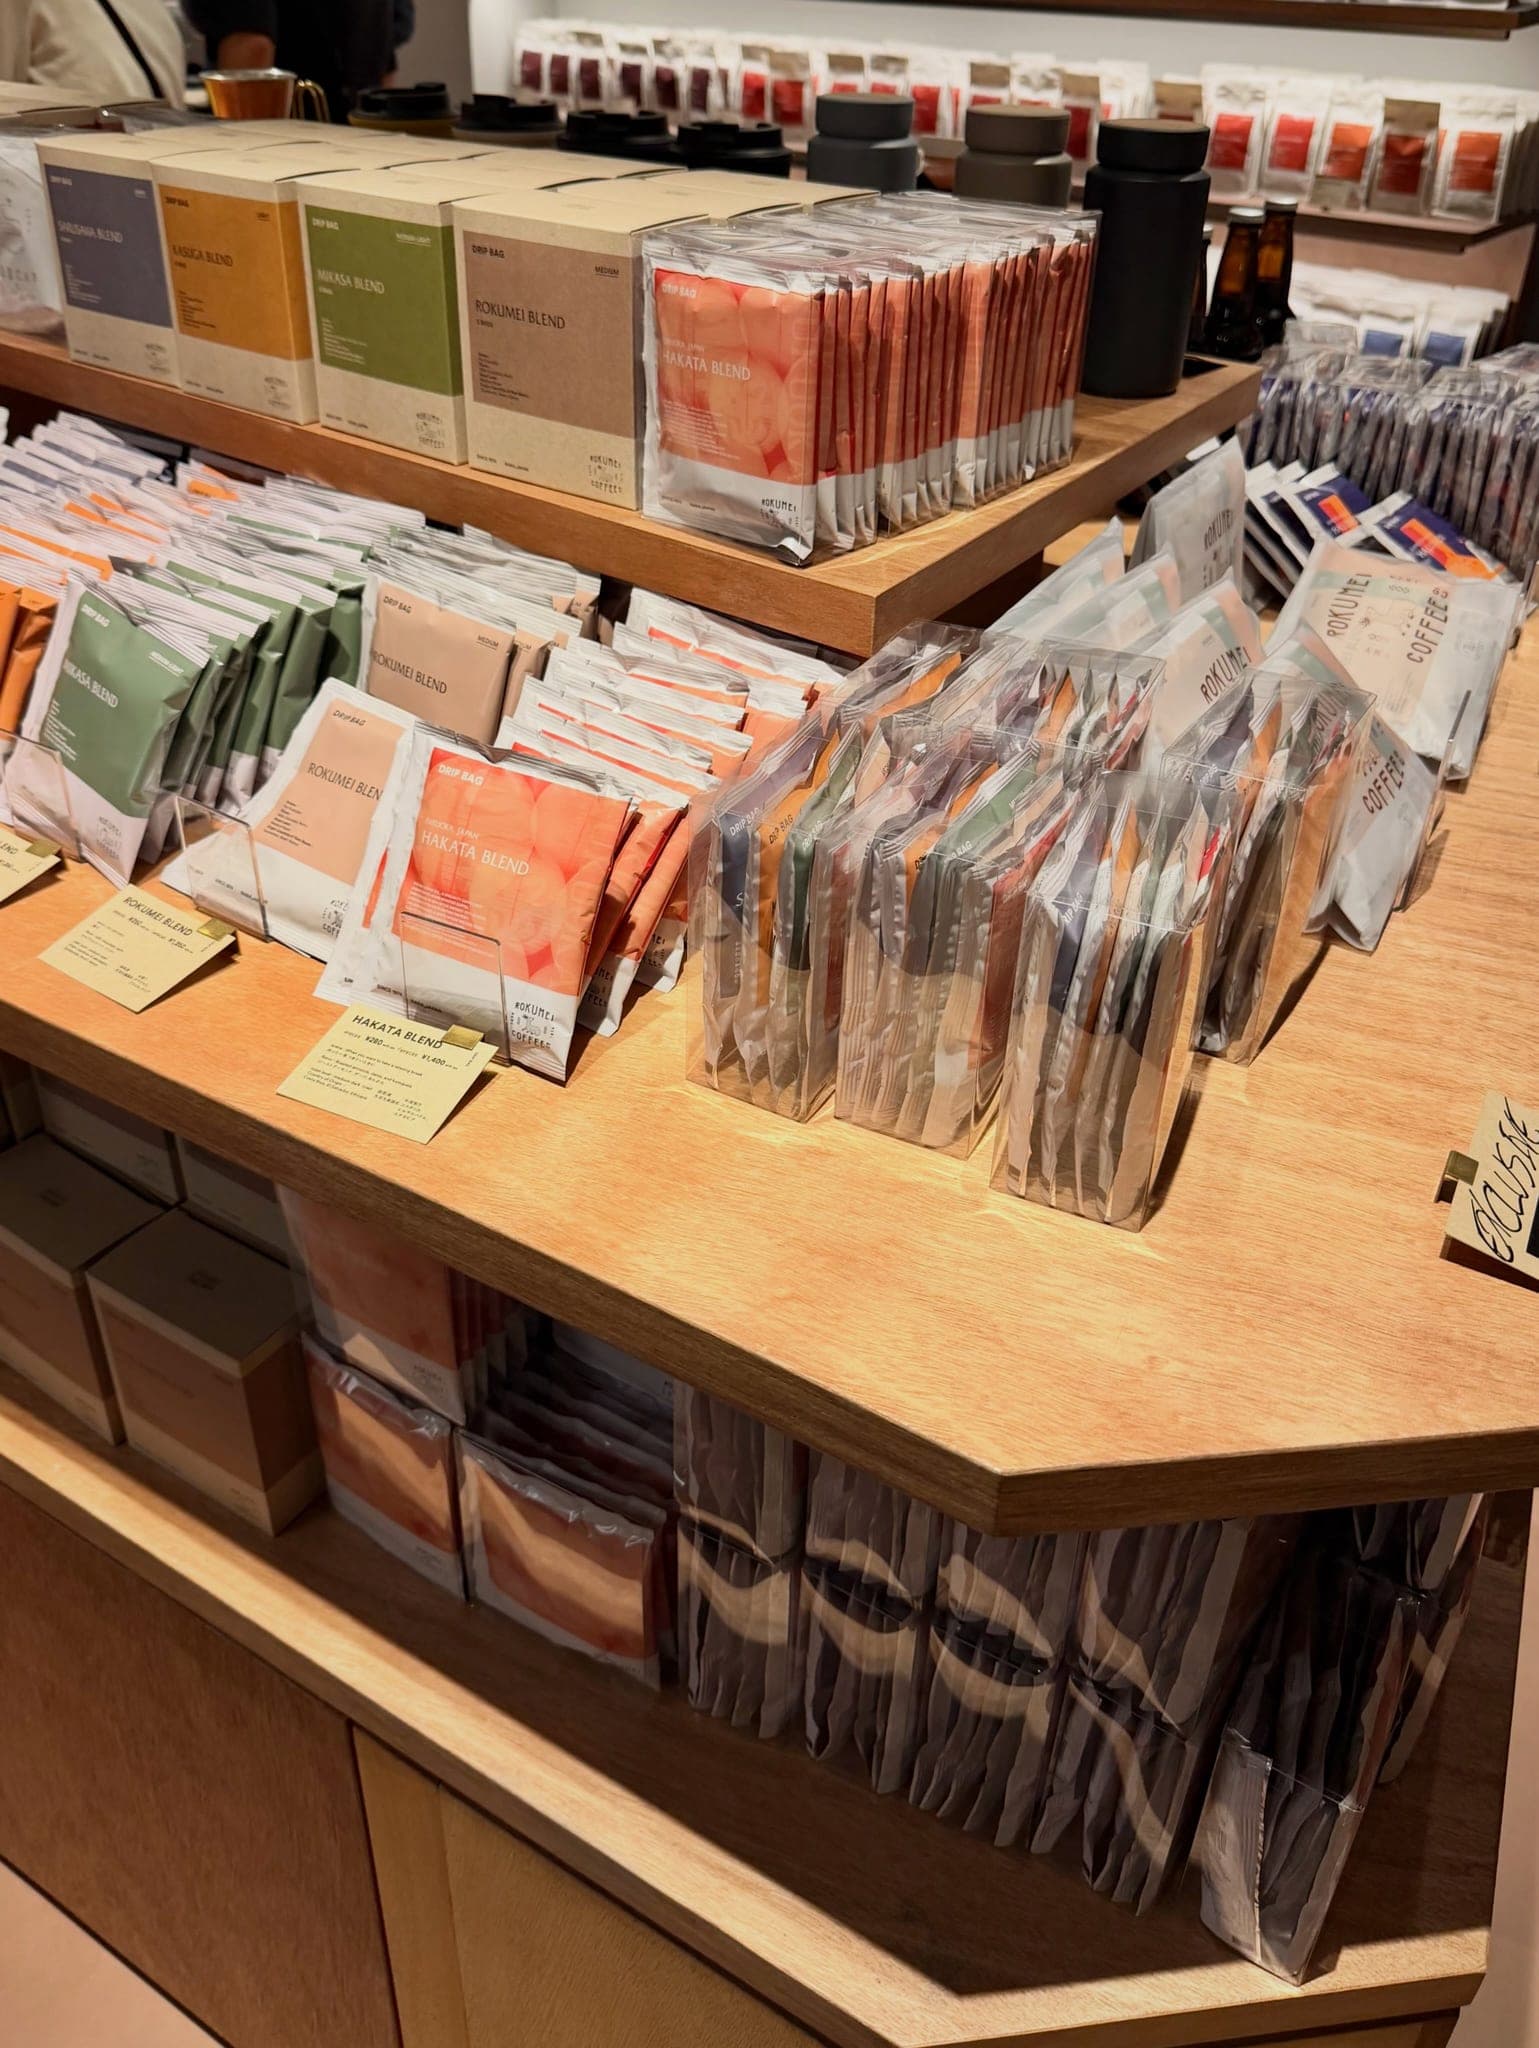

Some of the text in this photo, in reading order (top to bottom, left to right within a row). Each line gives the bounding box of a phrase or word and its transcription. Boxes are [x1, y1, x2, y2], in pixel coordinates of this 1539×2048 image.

[312, 217, 339, 230] DRIP BAG
[206, 250, 233, 267] BLEND
[472, 245, 504, 258] DRIP BAG
[594, 265, 619, 275] MEDIUM
[317, 269, 385, 295] MIKASA BLEND
[662, 283, 697, 298] DRIP BAG
[475, 299, 566, 330] ROKUMEI BLEND
[663, 352, 751, 381] HAKATA BLEND
[761, 498, 797, 512] ROKUMEI
[81, 603, 110, 628] DRIP BAG
[383, 595, 412, 614] DRIP BAG
[1326, 572, 1373, 638] ROKUMEI
[477, 634, 500, 648] MEDIUM
[372, 650, 448, 694] ROKUMEI BLEND
[1200, 646, 1252, 706] ROKUMEI
[91, 682, 119, 708] BLEND
[332, 709, 367, 727] DRIP BAG
[308, 762, 385, 801] ROKUMEI BLEN
[437, 764, 484, 786] DRIP BAG
[729, 819, 747, 837] DRIP
[421, 830, 530, 876] HAKATA BLEND
[123, 896, 193, 936] ROKUMEI BLEND
[514, 1001, 555, 1022] ROKUMEI
[352, 1014, 443, 1050] HAKATA BLEND
[511, 1029, 552, 1049] COFFEES
[364, 1035, 447, 1067] ¥280 ¥1,400
